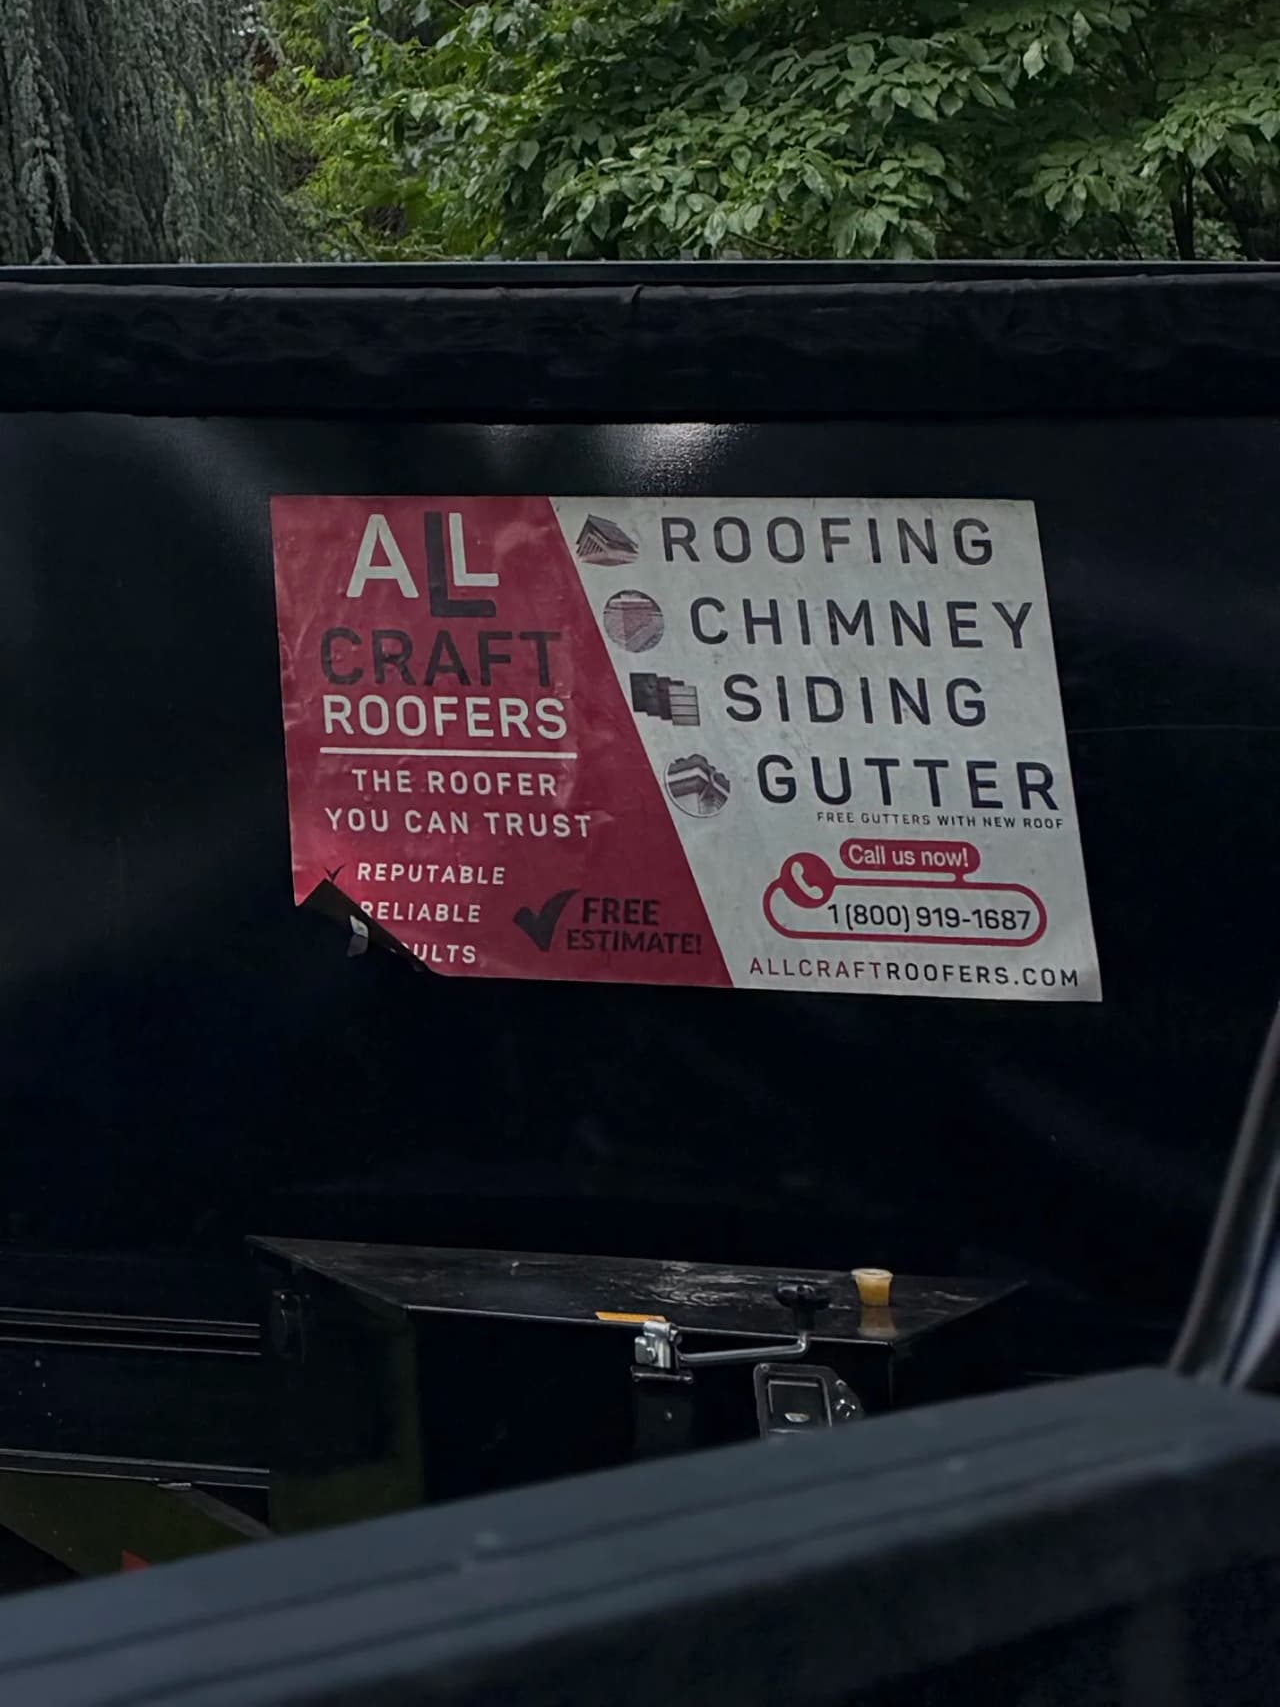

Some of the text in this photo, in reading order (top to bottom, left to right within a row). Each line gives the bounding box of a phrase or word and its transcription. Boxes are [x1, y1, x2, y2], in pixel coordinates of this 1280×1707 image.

[661, 516, 993, 565] ROOFING
[346, 511, 500, 618] ALL
[690, 596, 1033, 649] CHIMNEY
[320, 627, 562, 688] CRAFT
[723, 673, 987, 727] SIDING
[322, 694, 567, 739] ROOFERS
[351, 769, 557, 796] THE ROOFER
[756, 754, 1060, 811] GUTTER
[324, 807, 591, 837] YOU CAN TRUST
[816, 811, 1064, 830] FREE GUTTERS WITH NEW ROOF
[847, 843, 970, 868] Call us now!
[357, 862, 506, 885] REPUTABLE
[360, 900, 482, 924] RELIABLE
[581, 896, 661, 926] FREE
[828, 903, 1032, 933] 1 (800) 919-1687
[566, 928, 703, 955] ESTIMATE!
[749, 956, 1079, 987] ALLCRAFTROOFERS.COM
